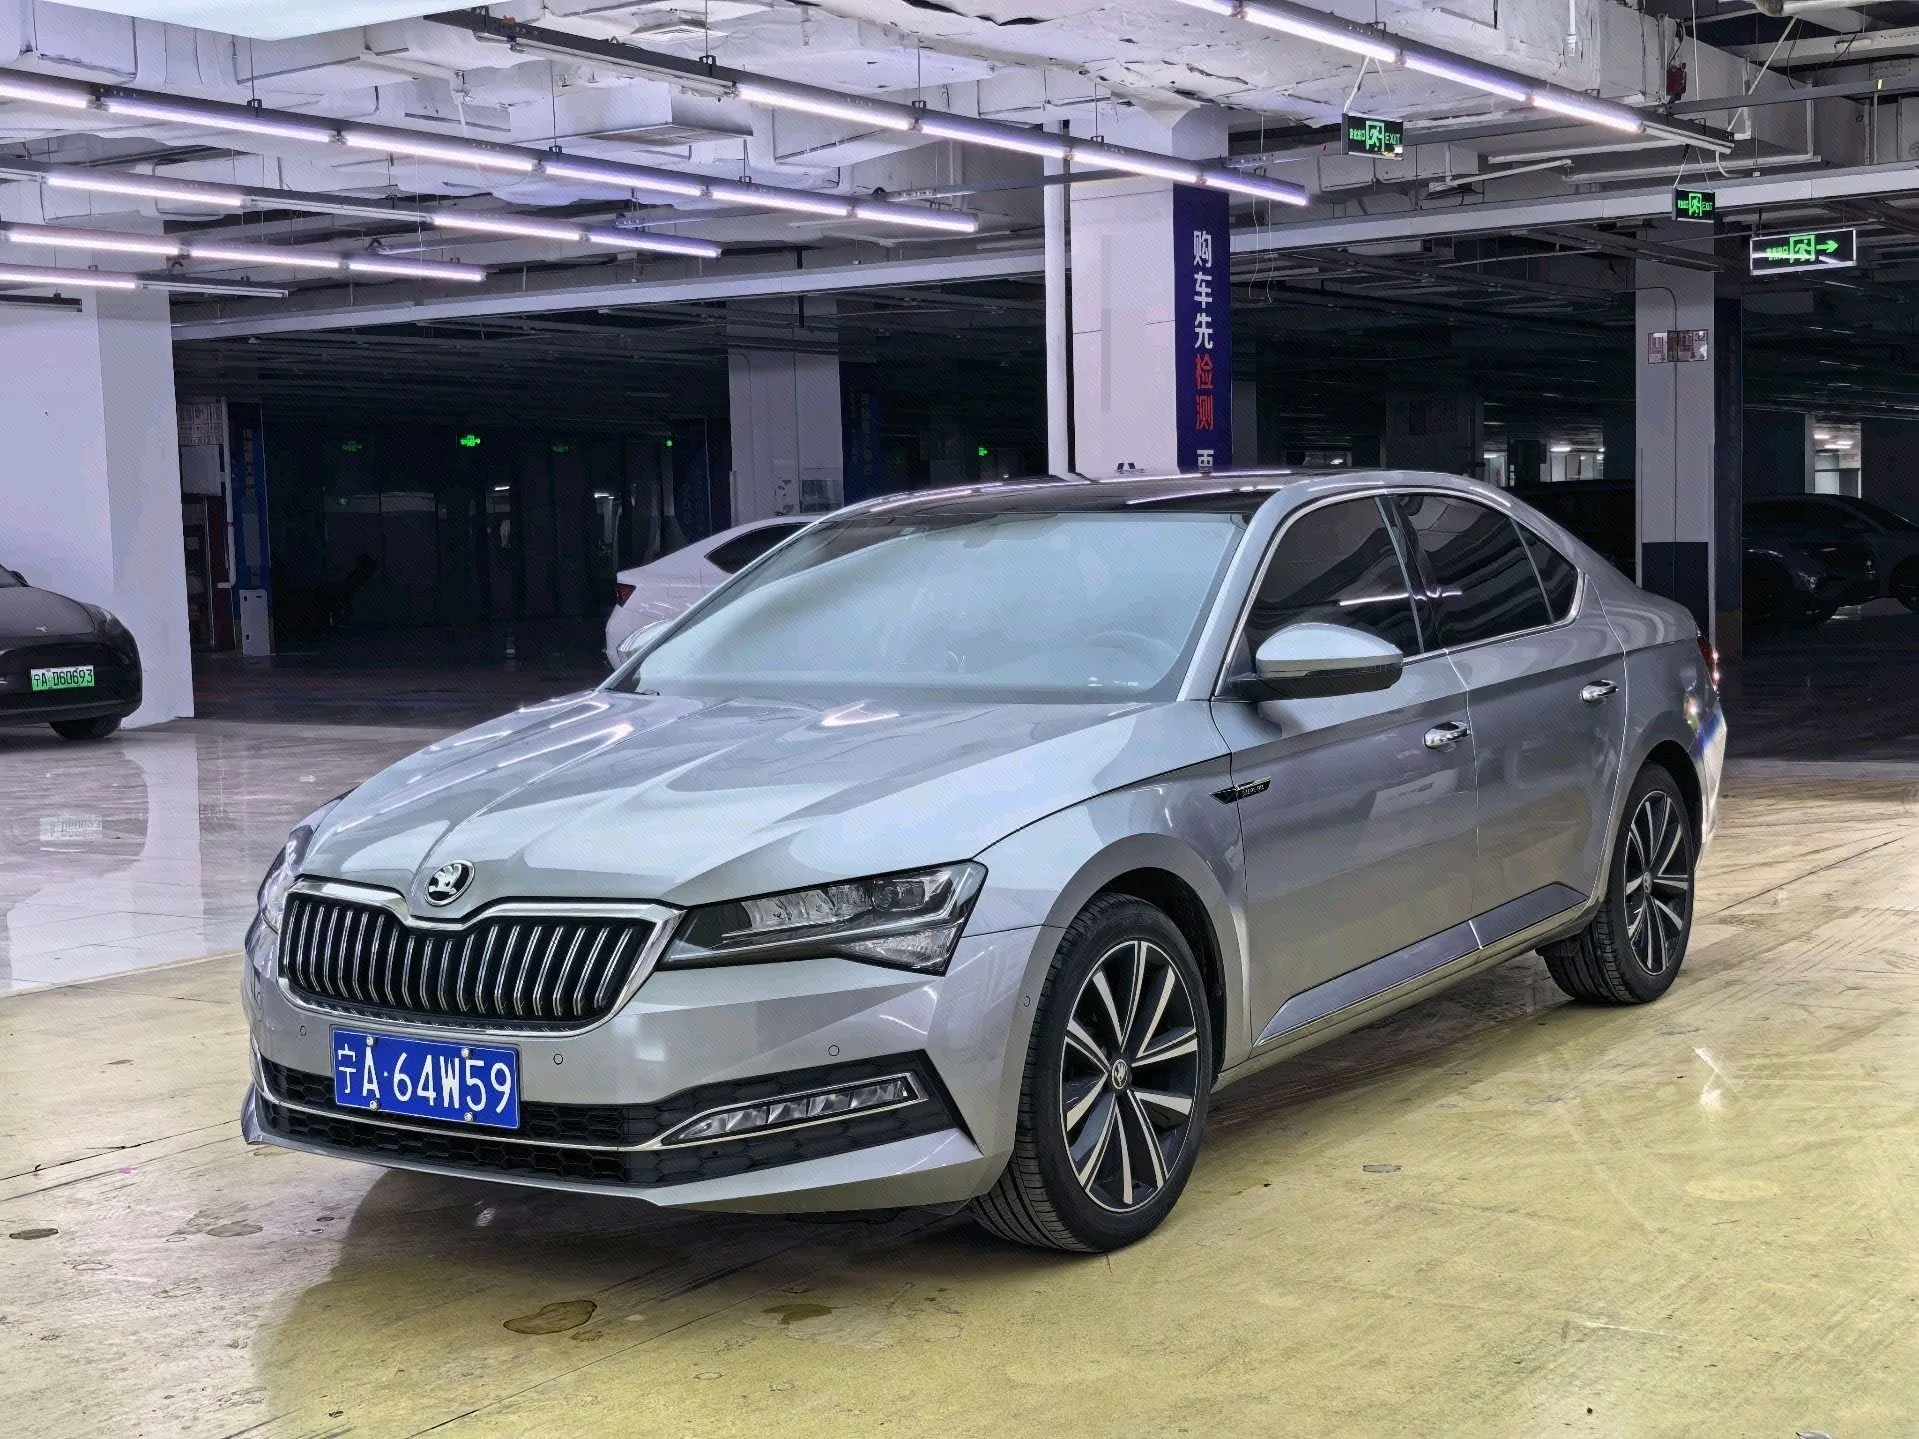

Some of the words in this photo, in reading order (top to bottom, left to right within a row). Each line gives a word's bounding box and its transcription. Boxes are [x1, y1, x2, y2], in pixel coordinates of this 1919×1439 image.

[1385, 132, 1400, 145] EXIT
[1193, 231, 1214, 430] 购车先检测
